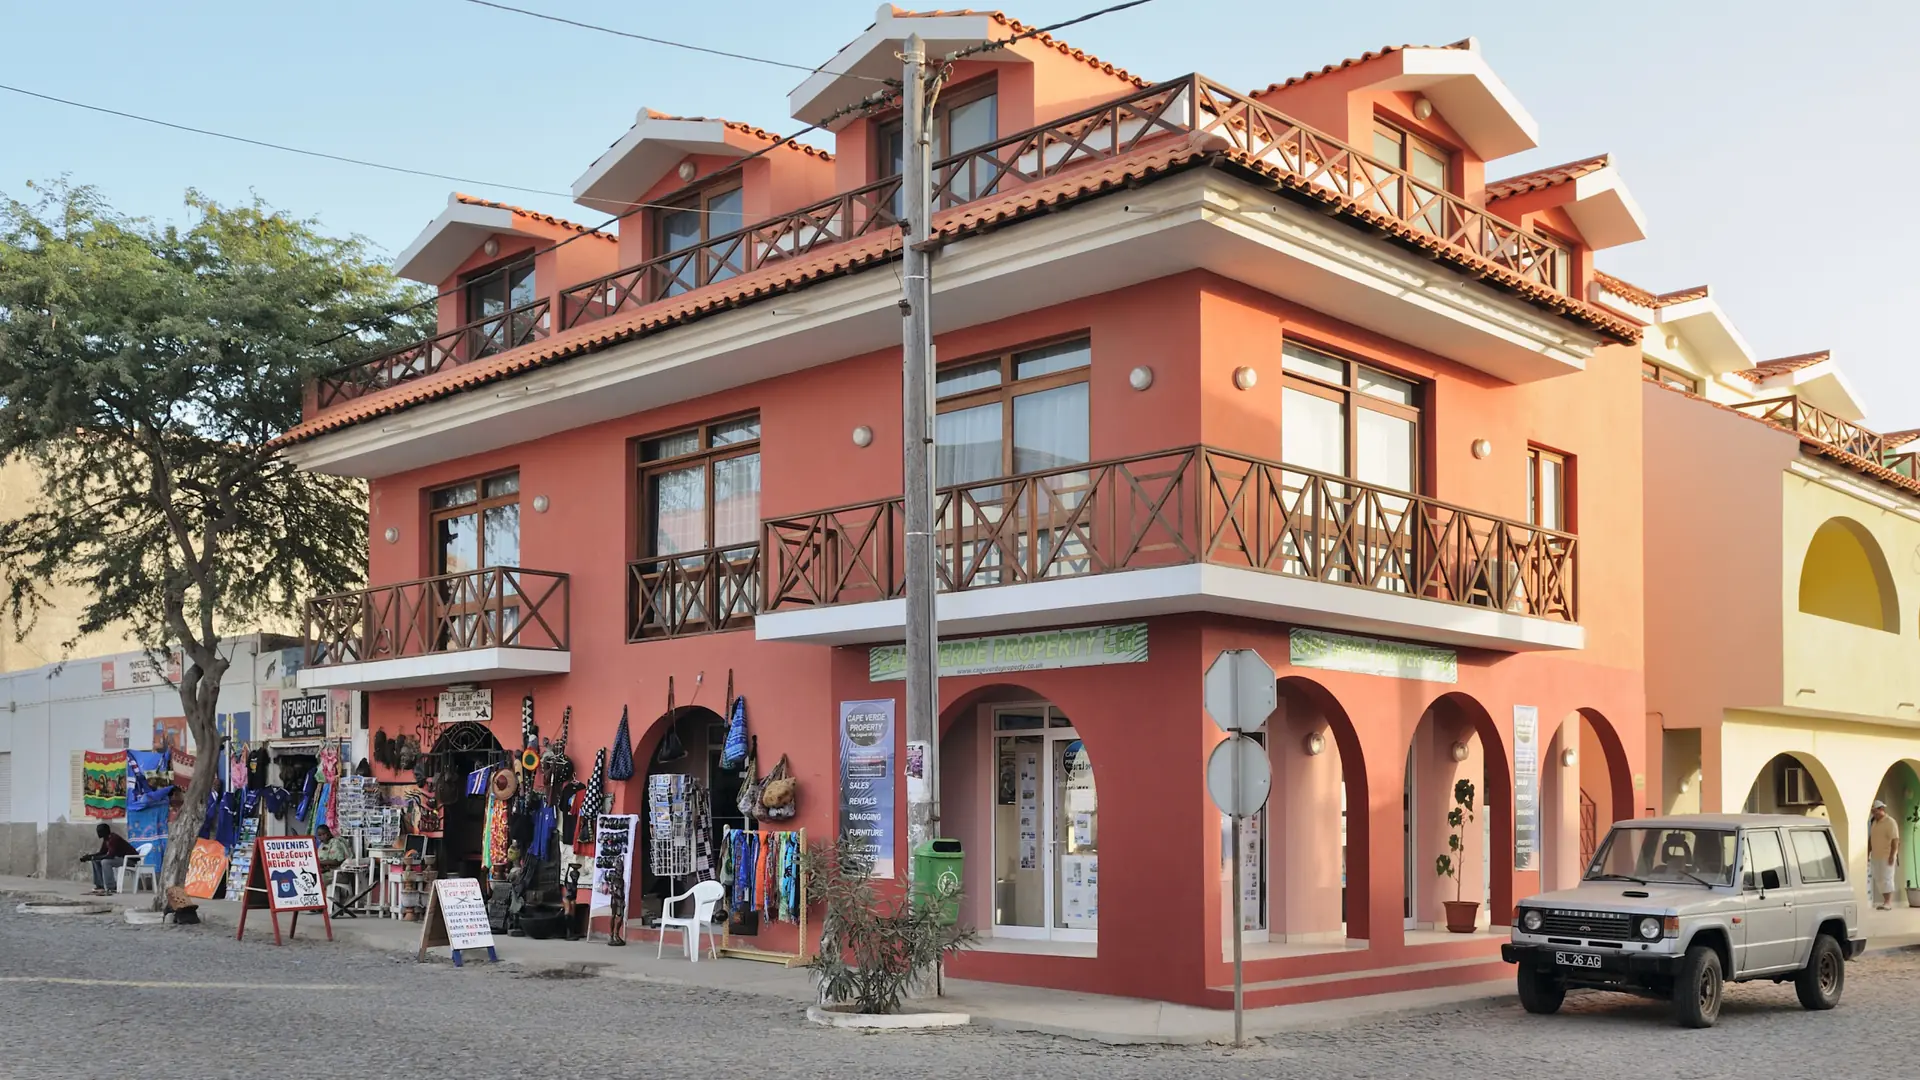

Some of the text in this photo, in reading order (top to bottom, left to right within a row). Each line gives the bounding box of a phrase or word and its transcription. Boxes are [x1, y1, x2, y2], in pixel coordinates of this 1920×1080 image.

[937, 640, 987, 668] ERDE
[993, 629, 1099, 663] PROPERTY
[847, 713, 886, 723] CAPE VERDE
[849, 723, 883, 732] PROPERTY
[849, 782, 870, 790] SALES
[849, 797, 877, 805] RENTALS
[849, 813, 881, 821] SNAGGING
[849, 829, 884, 837] FURNITURE
[1554, 909, 1620, 919] MITSUBISHI
[1557, 952, 1601, 968] SL 26 AG
